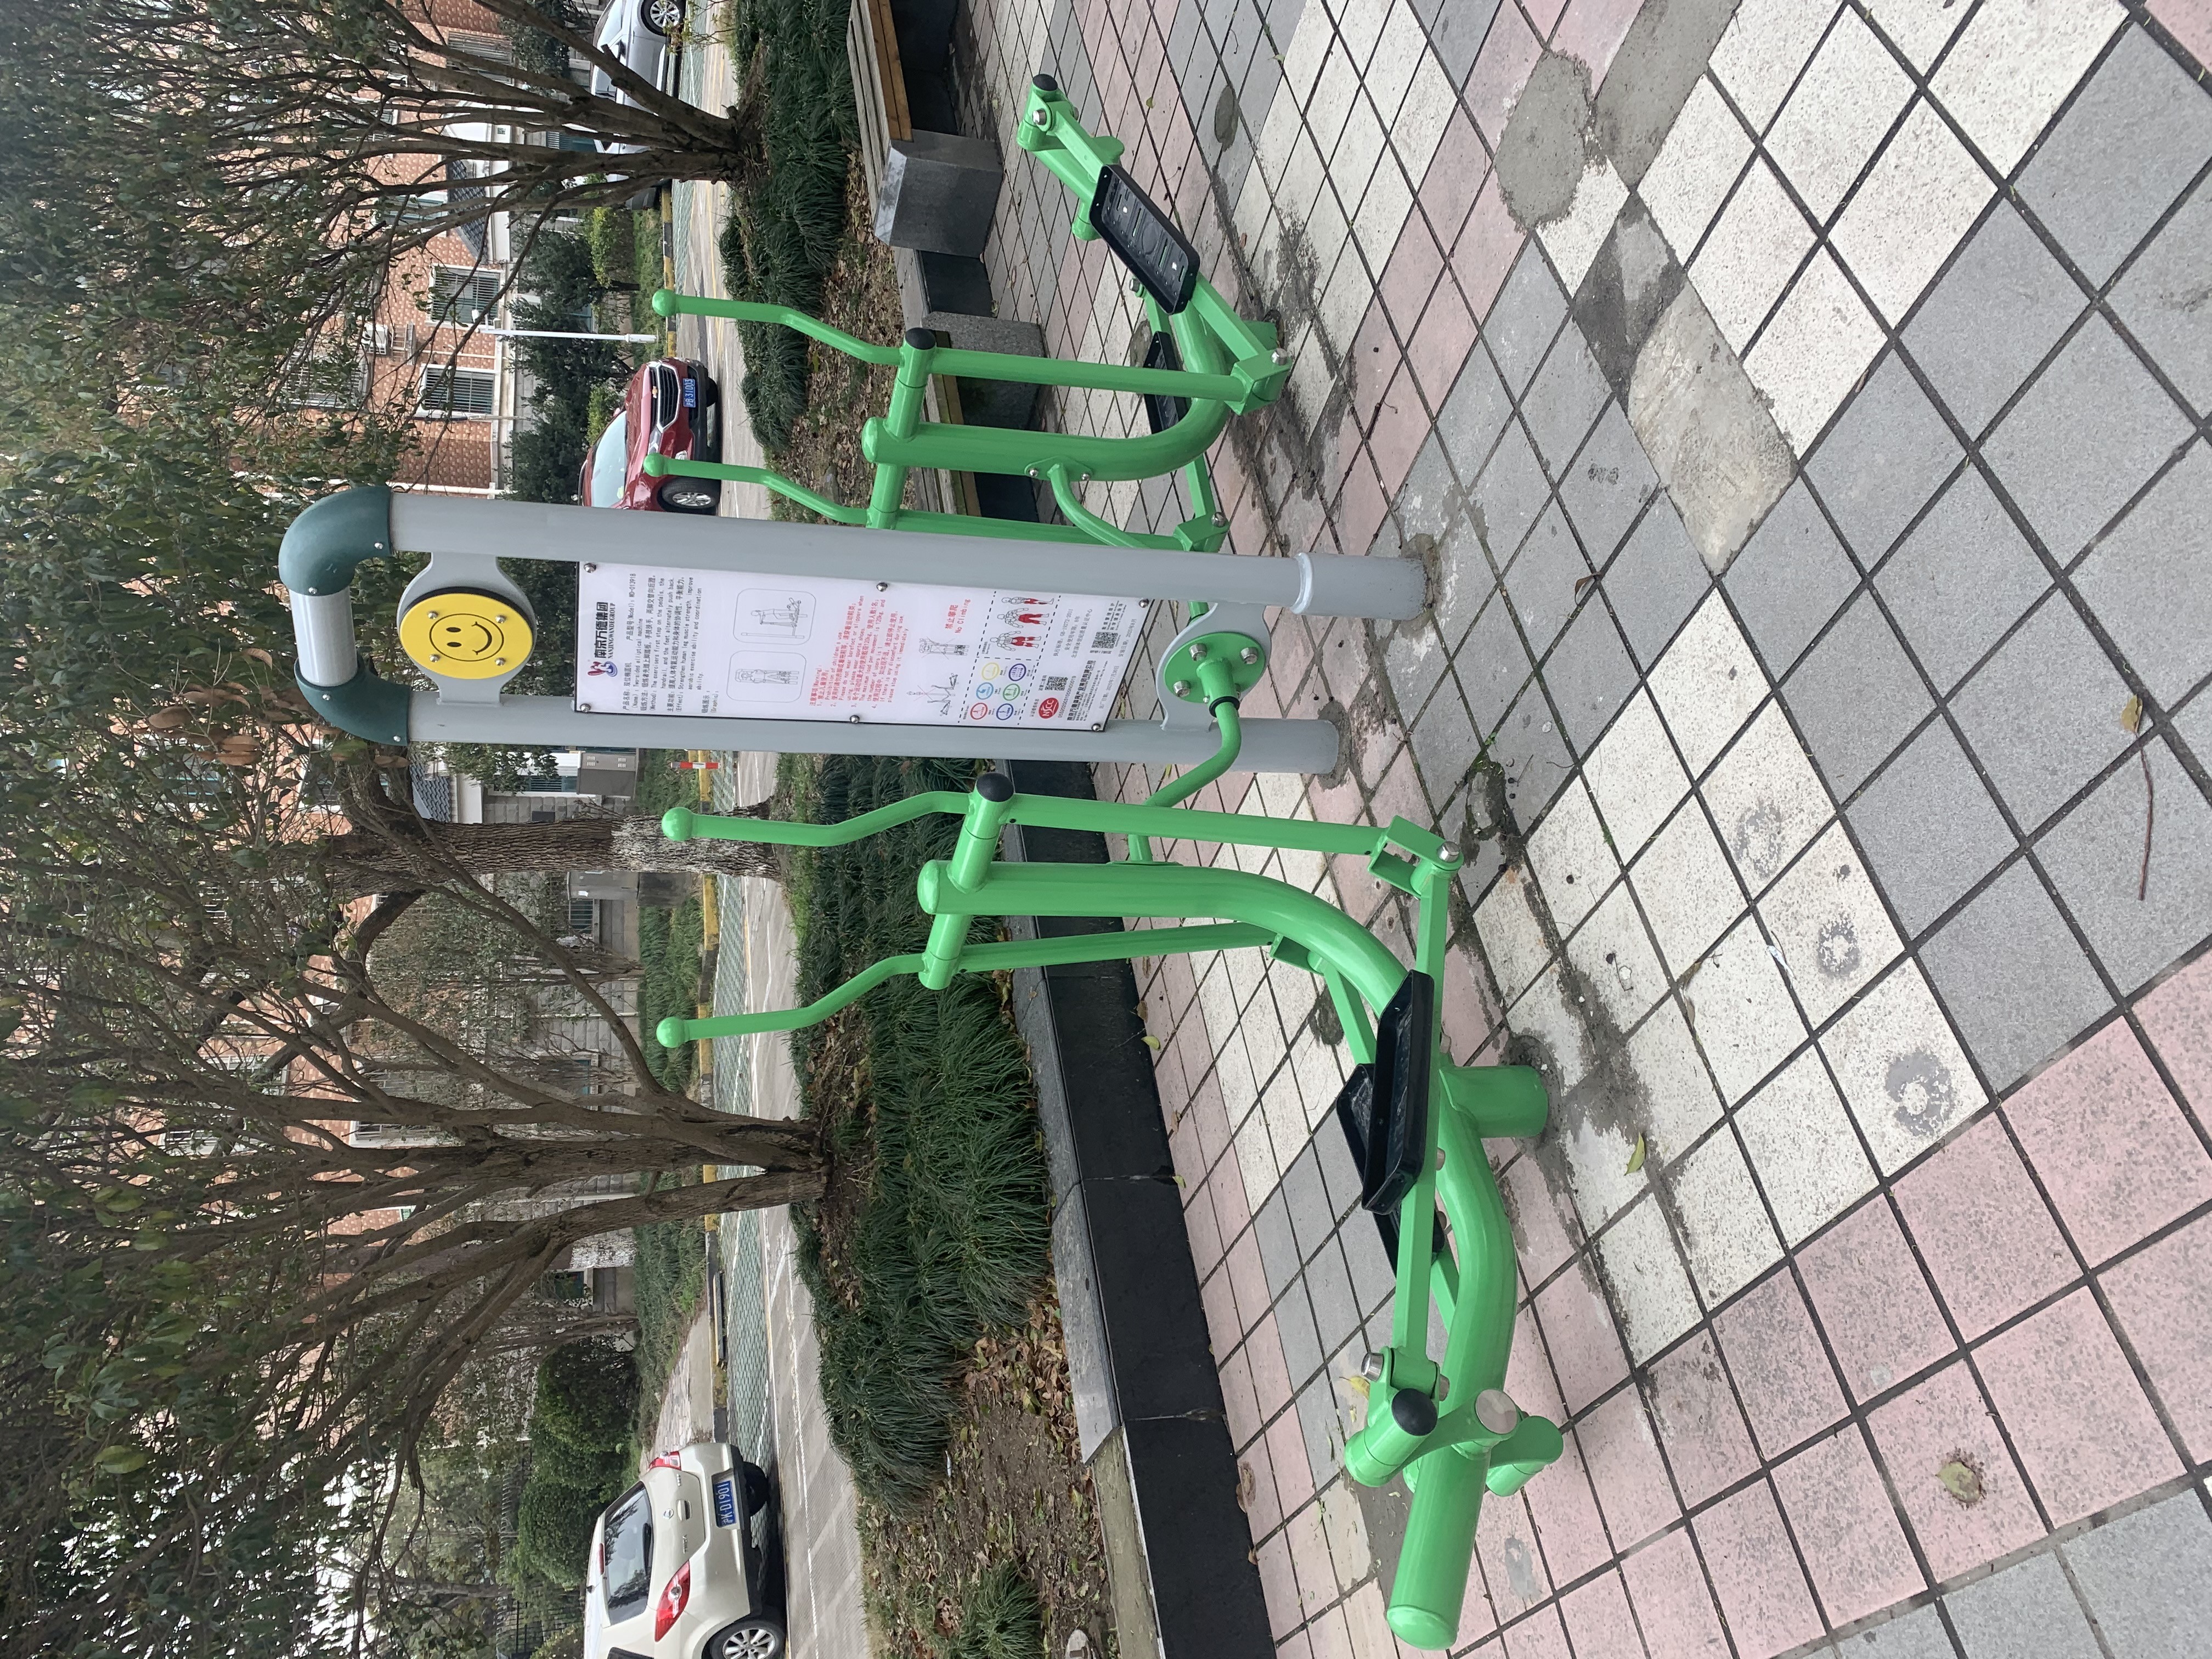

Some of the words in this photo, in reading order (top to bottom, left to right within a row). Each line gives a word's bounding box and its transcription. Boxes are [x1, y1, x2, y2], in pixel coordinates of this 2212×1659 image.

[694, 588, 702, 620] coordination
[957, 599, 971, 624] Climbing
[664, 605, 673, 633] alternately
[945, 605, 958, 629] 禁止攀爬
[594, 602, 608, 658] 南京万德集团
[691, 632, 699, 649] ability
[894, 625, 902, 640] during
